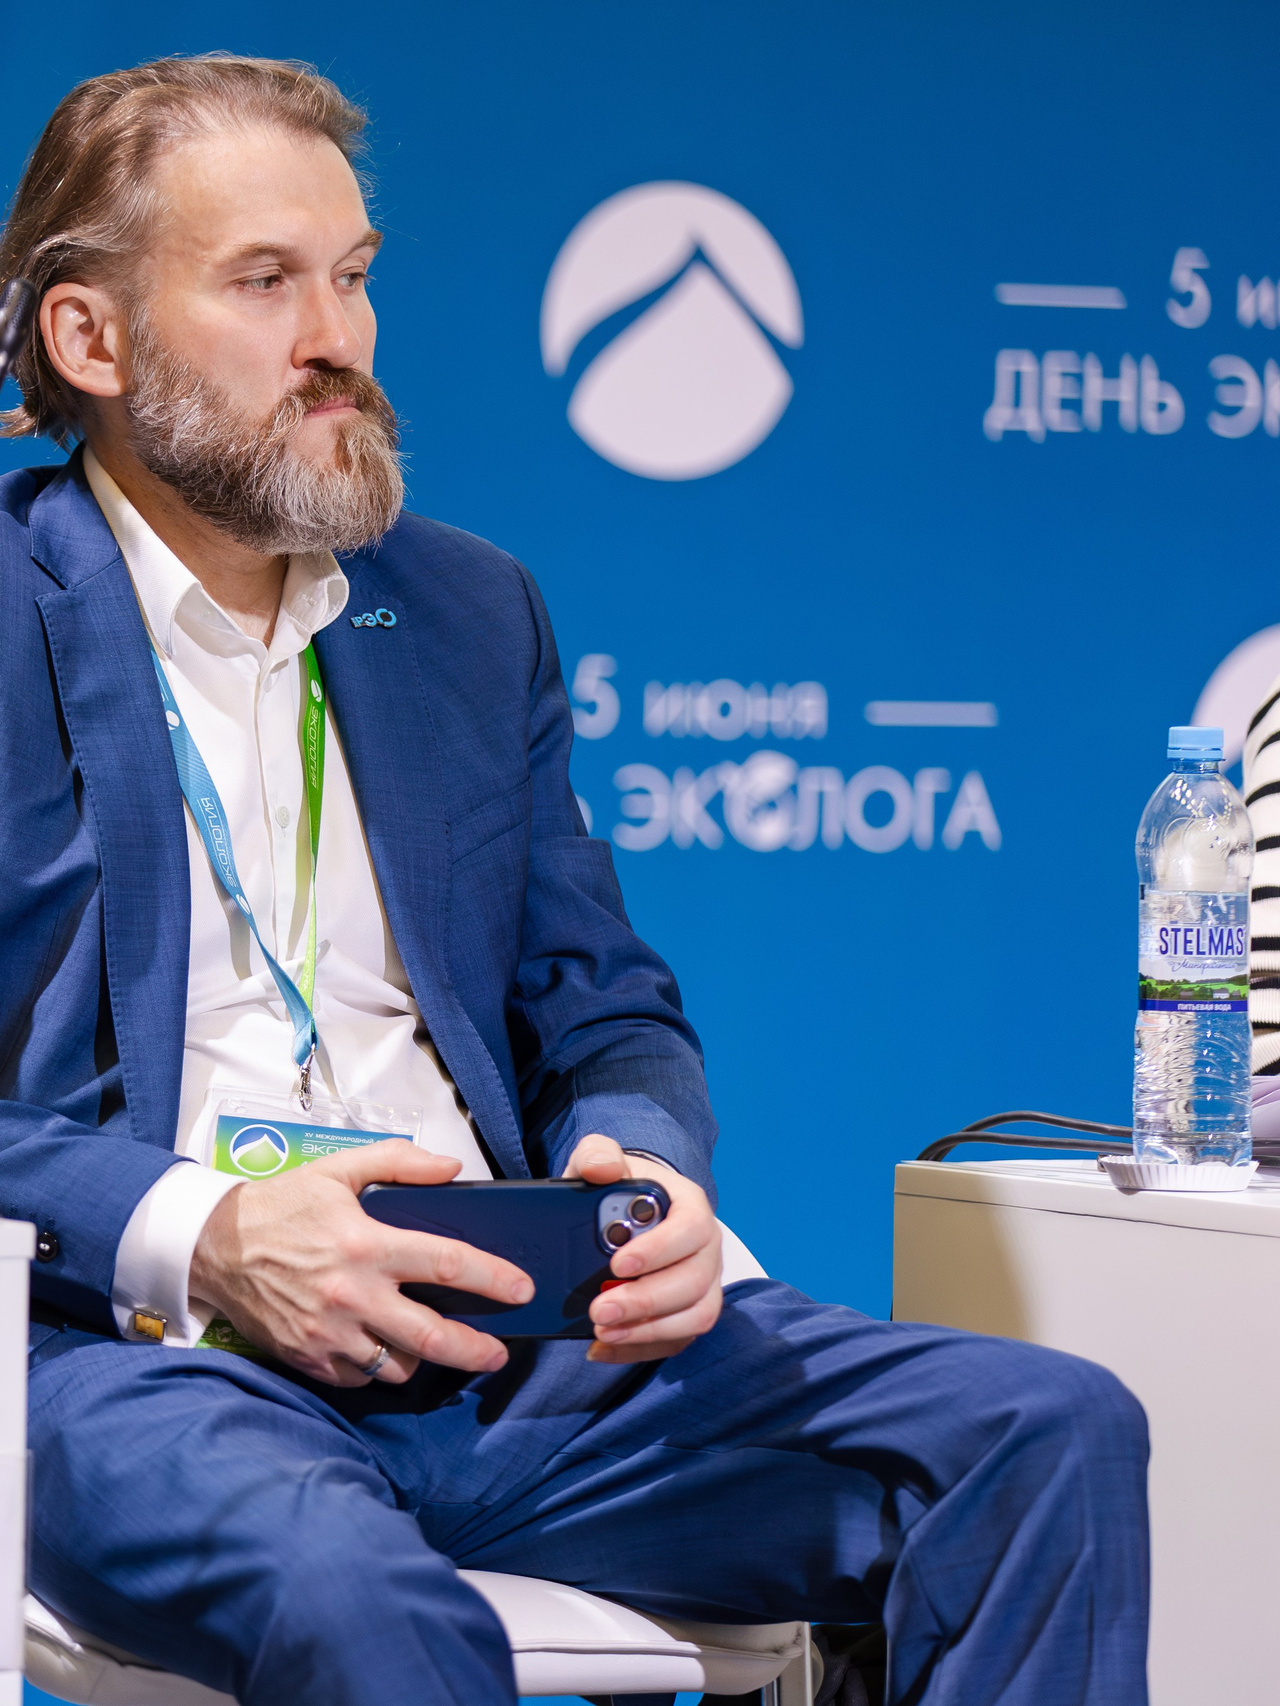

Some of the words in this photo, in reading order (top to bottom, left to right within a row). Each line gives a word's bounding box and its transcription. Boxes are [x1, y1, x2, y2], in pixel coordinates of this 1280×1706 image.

[1166, 247, 1212, 329] 5
[982, 348, 1186, 444] ДЕНЬ
[572, 653, 620, 740] 5
[613, 749, 1003, 854] ЭКОЛОГА
[1159, 926, 1244, 956] STELMAS
[301, 1143, 349, 1156] ЭКО
[315, 1133, 375, 1145] МЕЖДУНАРОДНЫЙ
